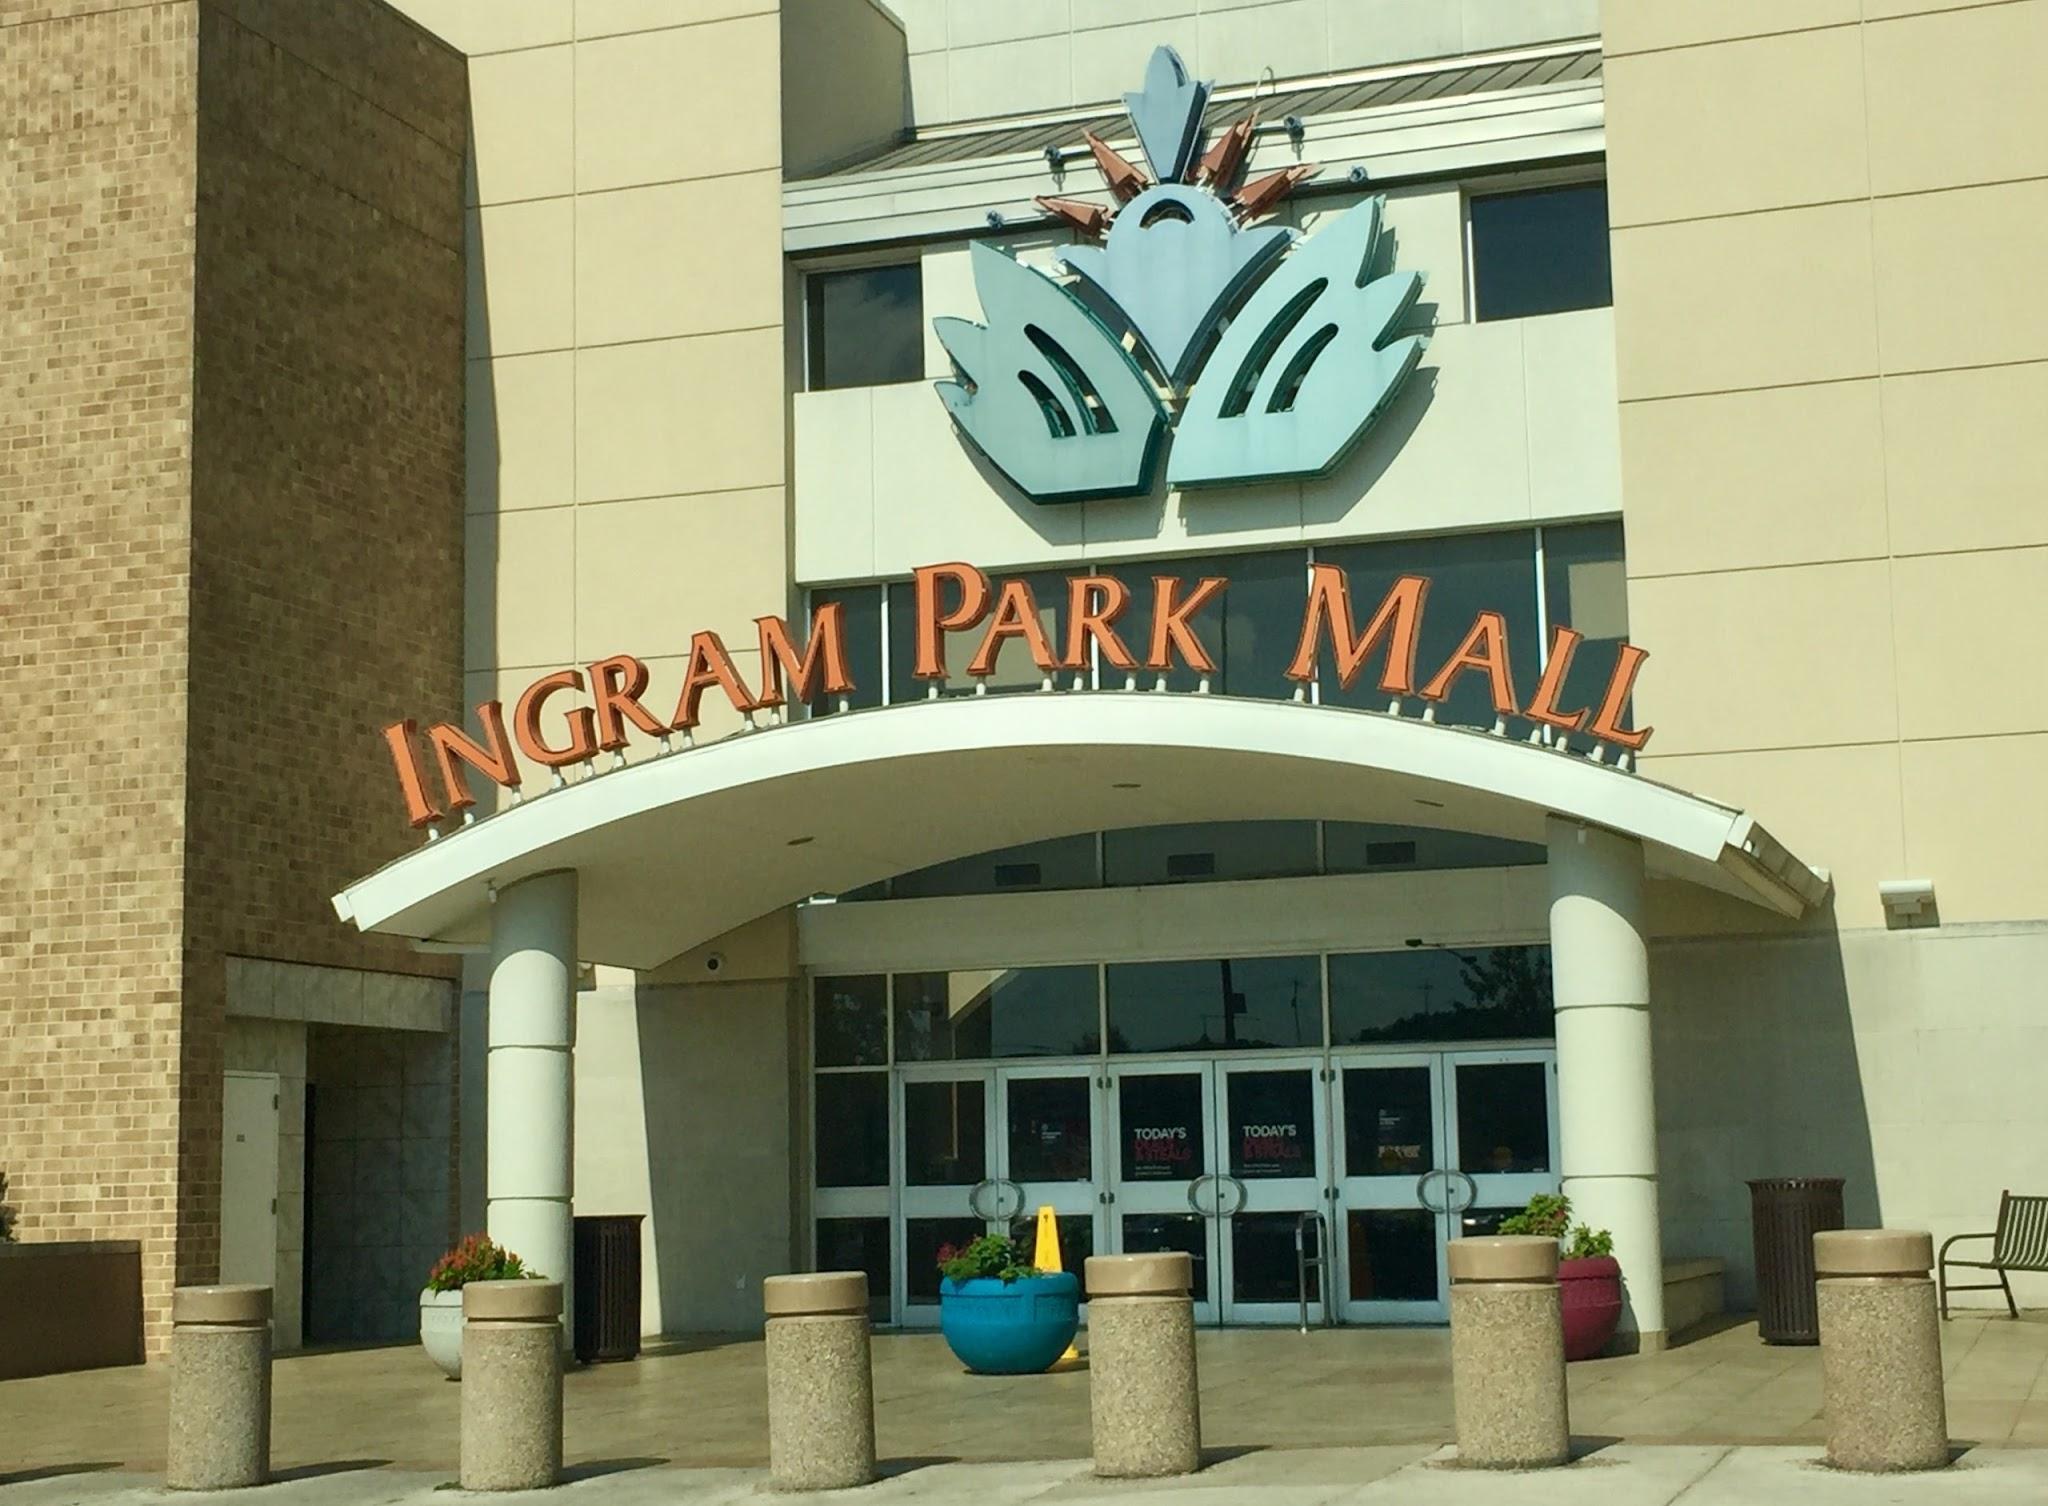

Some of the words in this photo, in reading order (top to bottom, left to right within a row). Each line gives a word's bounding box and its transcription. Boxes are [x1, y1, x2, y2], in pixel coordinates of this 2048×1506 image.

[382, 601, 856, 828] INGRAM
[912, 561, 1228, 679] PARK
[1283, 562, 1653, 751] MALL
[1133, 1127, 1187, 1140] TODAY'S
[1242, 1124, 1297, 1138] TODAY'S
